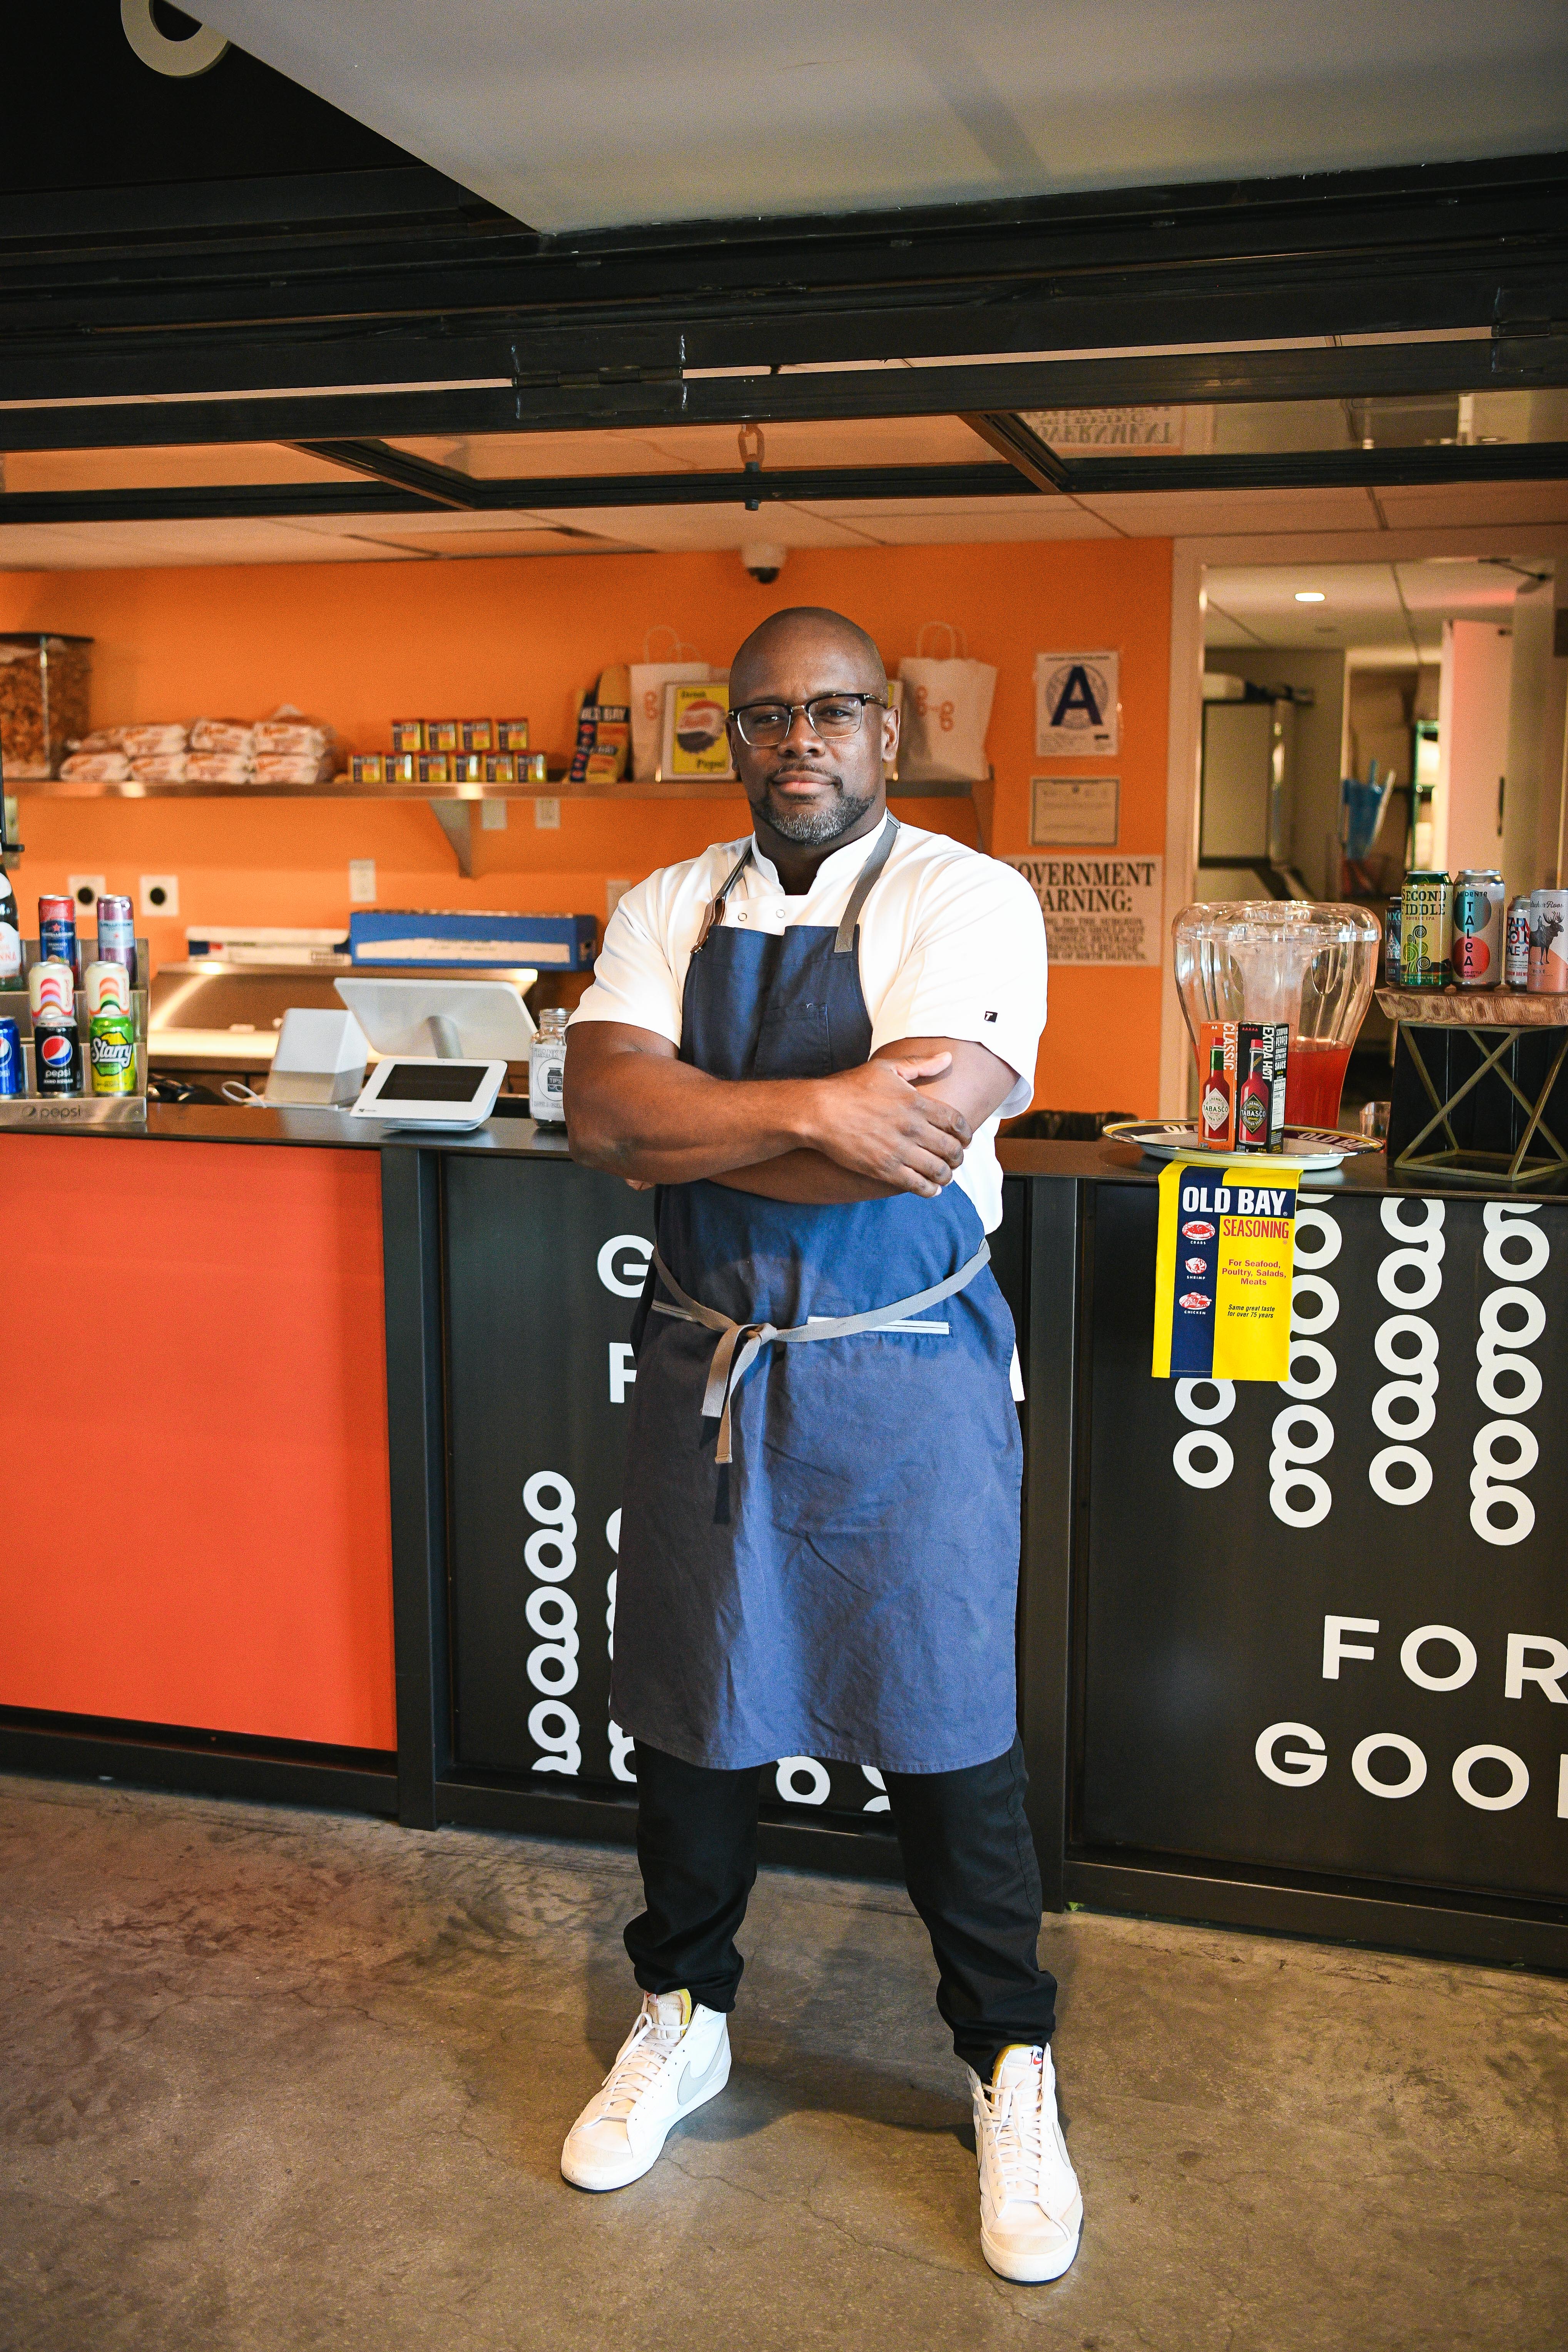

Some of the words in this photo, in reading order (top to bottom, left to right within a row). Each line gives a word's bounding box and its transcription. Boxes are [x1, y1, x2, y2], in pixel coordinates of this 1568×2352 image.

[1051, 665, 1103, 726] A
[1008, 863, 1155, 886] OVERNMENT
[1038, 888, 1132, 912] ARNING:
[1402, 888, 1446, 901] SECOND
[1223, 1023, 1235, 1071] CLASSIC
[1262, 1026, 1275, 1059] EXTRA
[1275, 1035, 1287, 1046] PEPPER
[92, 1037, 133, 1067] Starry
[46, 1068, 70, 1078] pepsi
[1262, 1060, 1273, 1082] HOT
[1275, 1060, 1286, 1071] SAUCE
[40, 1104, 80, 1118] pepsi
[1163, 1125, 1199, 1134] OL
[1298, 1132, 1340, 1143] OLD
[1183, 1187, 1230, 1213] OLD
[1238, 1189, 1287, 1215] BAY
[1224, 1219, 1289, 1239] SEASONING
[1222, 1268, 1253, 1277] Poultry,
[1256, 1269, 1287, 1279] Salads,
[1245, 1260, 1281, 1269] Seafood,
[1322, 1615, 1568, 1705] FOR
[1255, 1722, 1568, 1819] GOO
